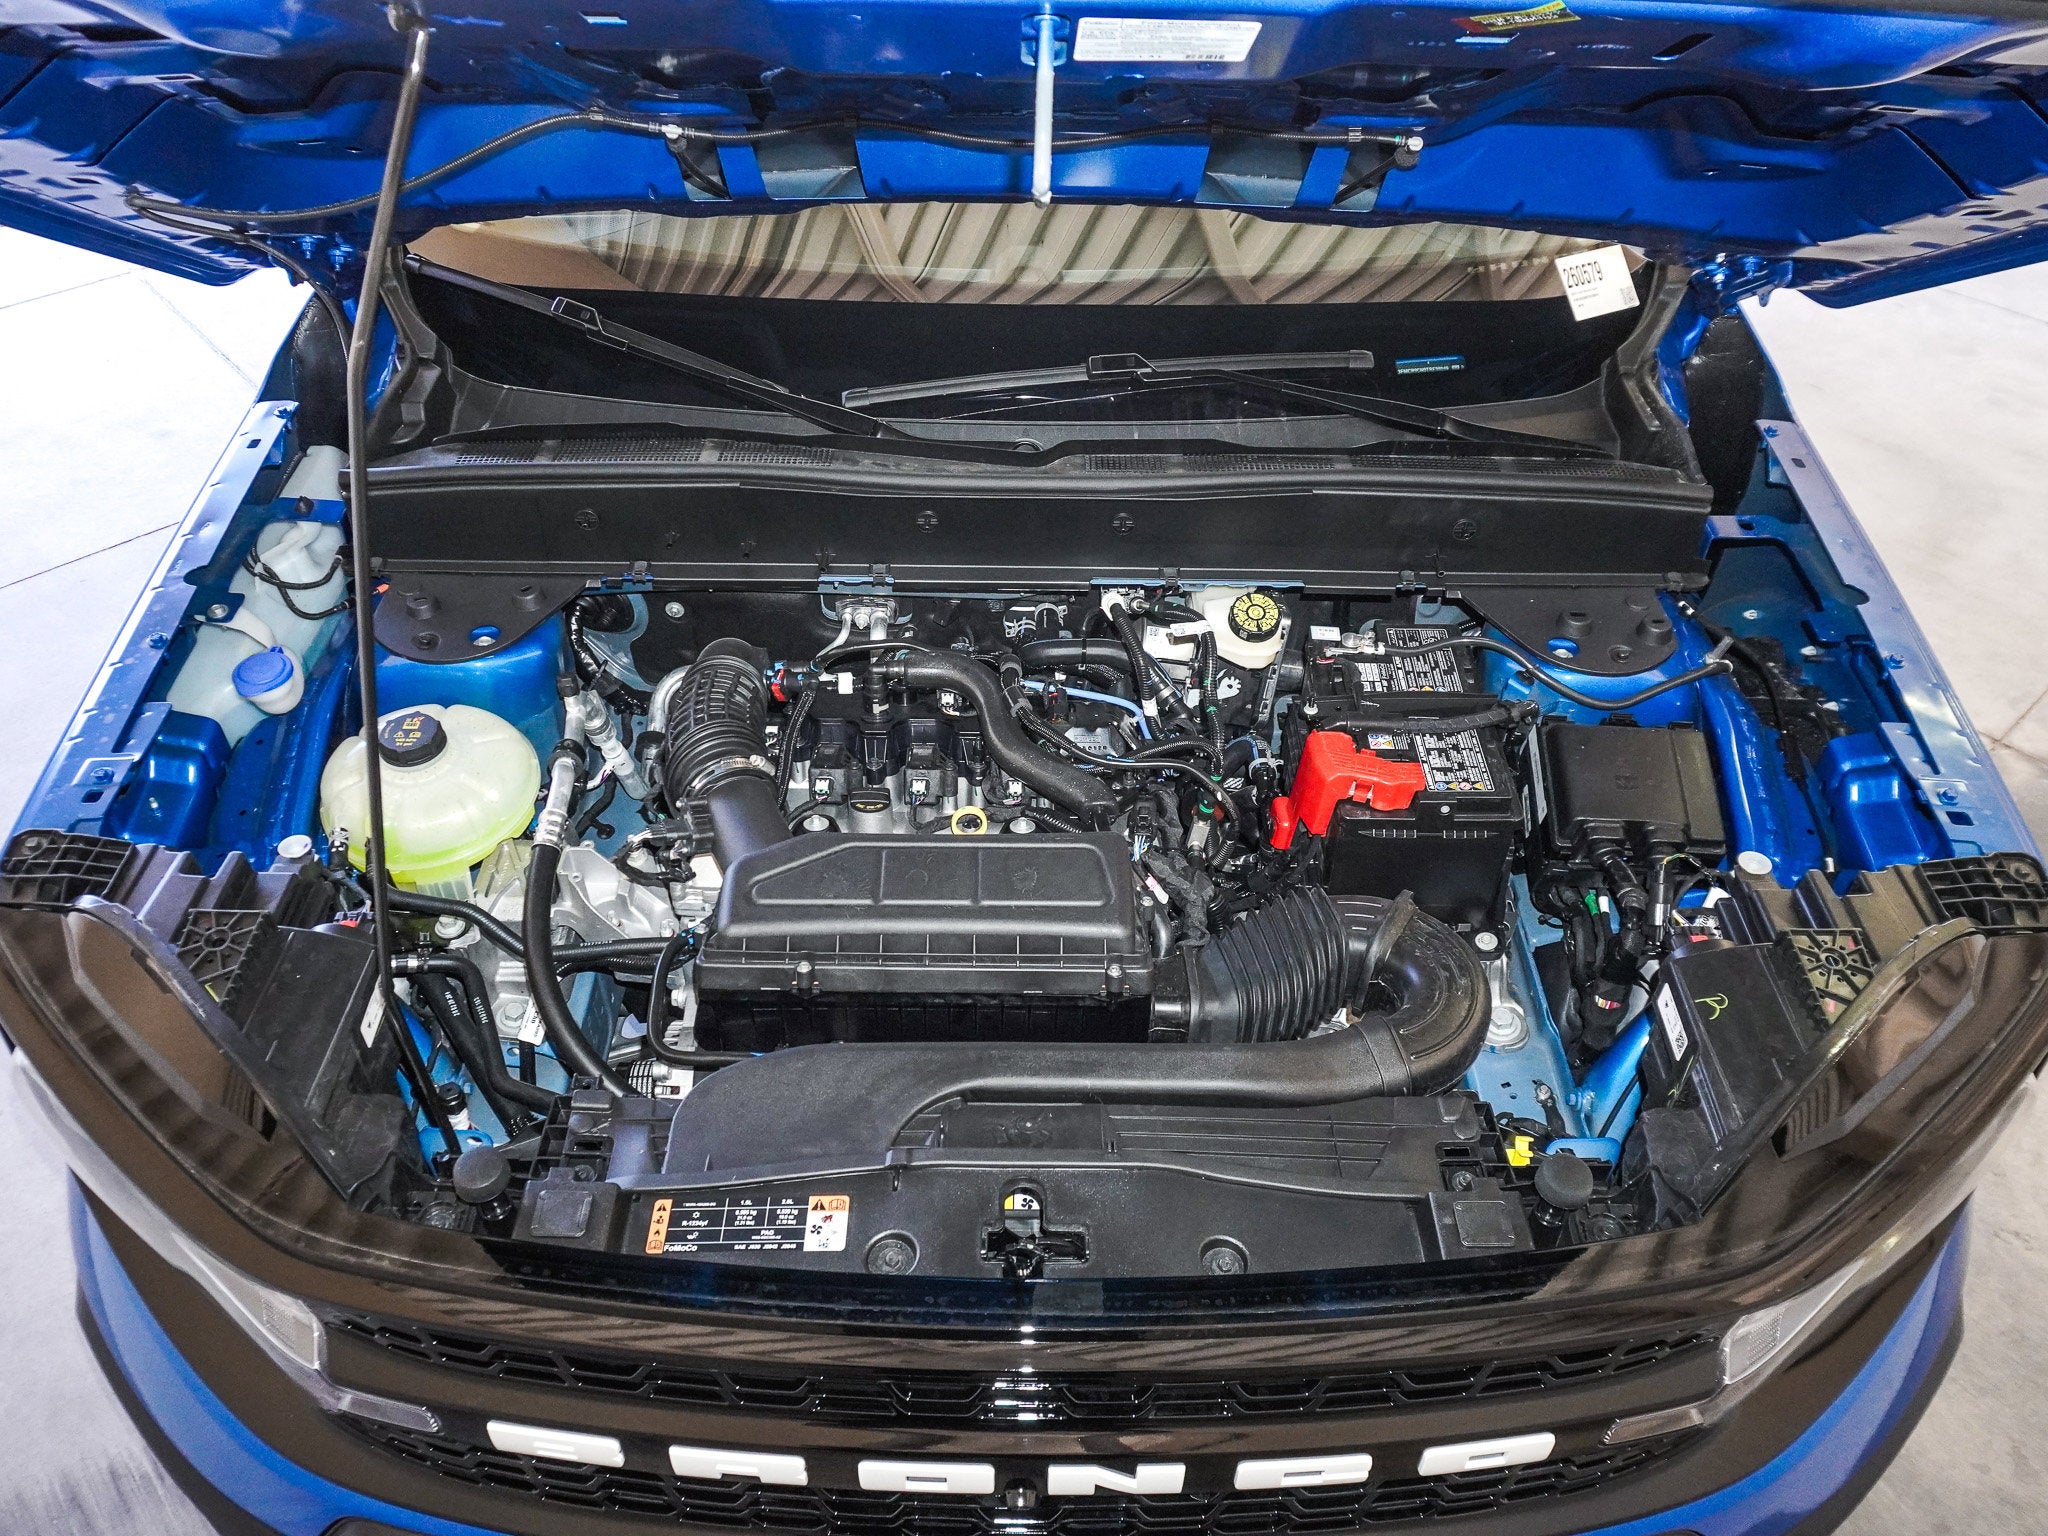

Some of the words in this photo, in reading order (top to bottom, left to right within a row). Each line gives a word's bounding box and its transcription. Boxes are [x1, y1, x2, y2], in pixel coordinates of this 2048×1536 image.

[1562, 260, 1604, 289] 260579
[681, 1219, 709, 1227] R-1234yf
[663, 1244, 698, 1252] FoMoCo
[486, 1419, 1556, 1496] BRONCO
